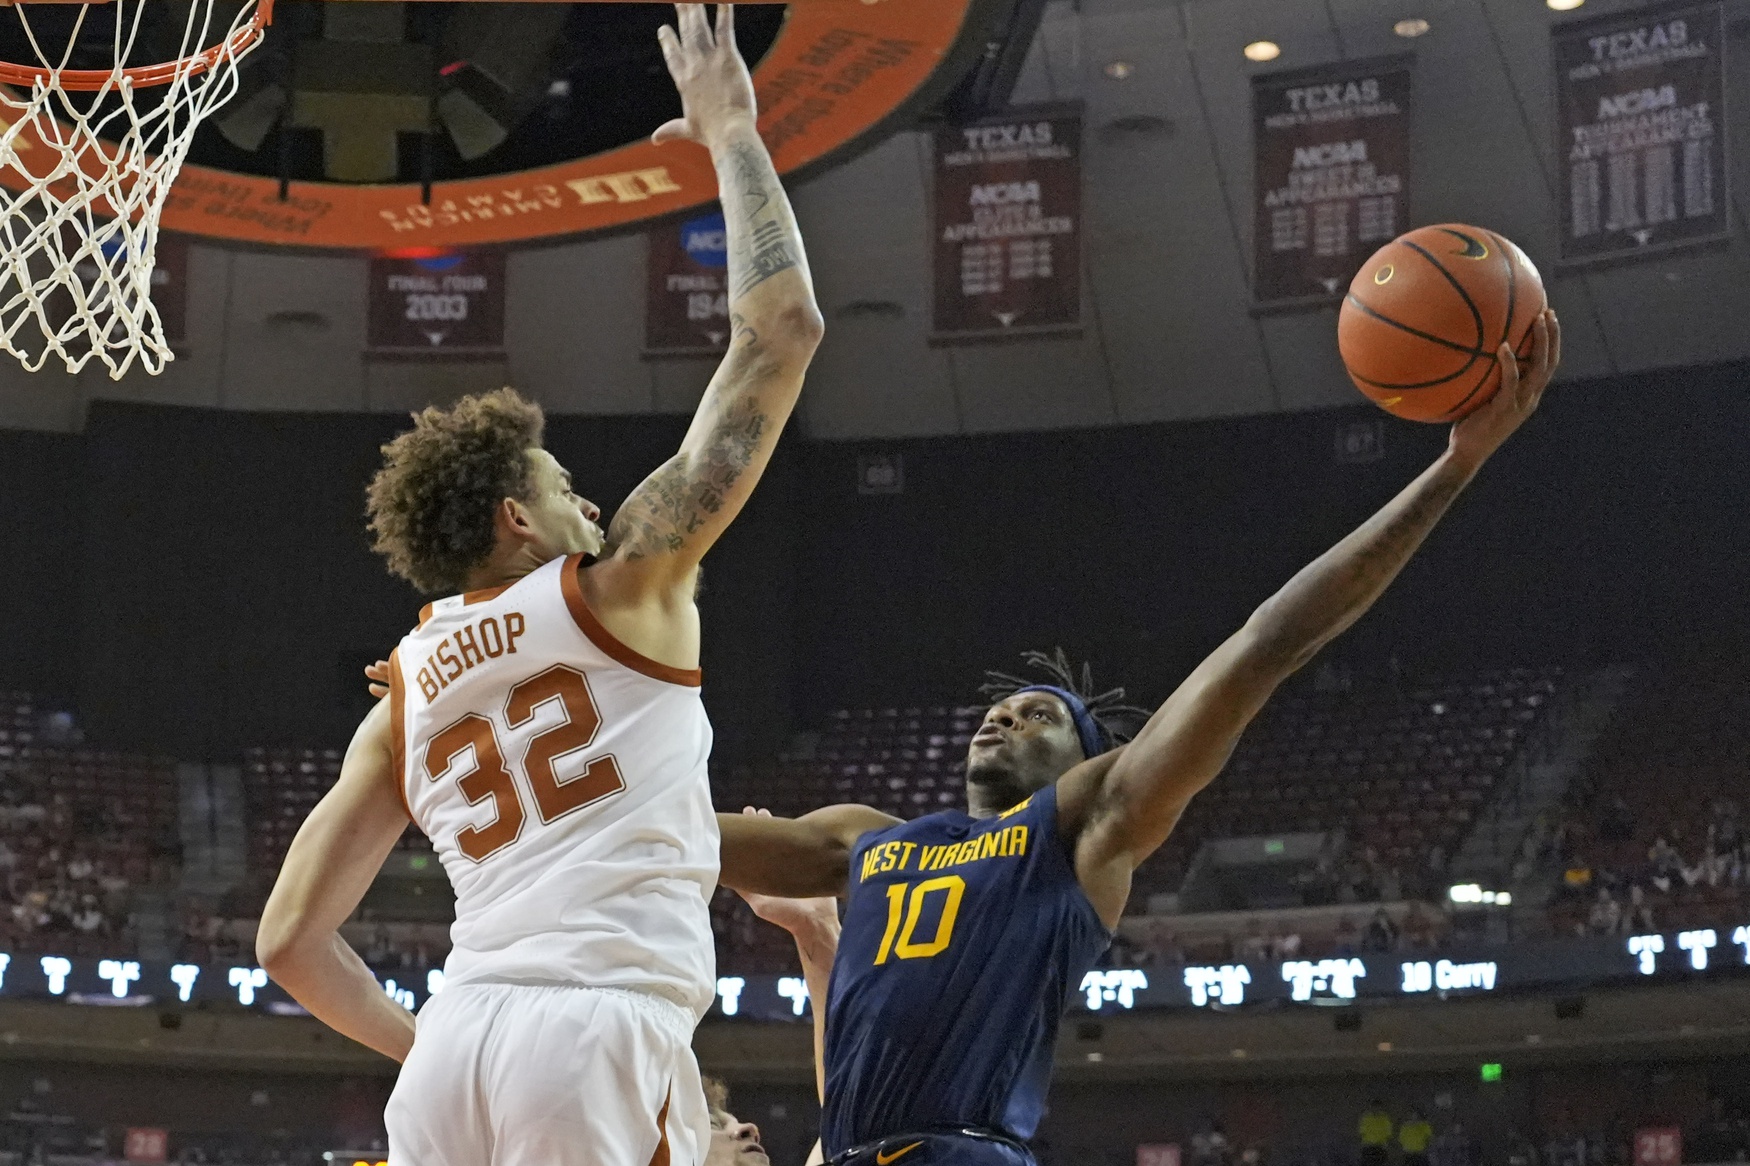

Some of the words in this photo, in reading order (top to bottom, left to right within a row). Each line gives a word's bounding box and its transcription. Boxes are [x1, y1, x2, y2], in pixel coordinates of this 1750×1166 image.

[1588, 20, 1687, 60] TEXAS
[1286, 78, 1380, 112] TEXAS
[963, 121, 1053, 149] TEXAS
[416, 611, 526, 704] BISHOP
[421, 662, 627, 865] 32
[918, 825, 1029, 871] VIRGINIA
[872, 874, 966, 966] 10
[1436, 959, 1497, 991] Curry
